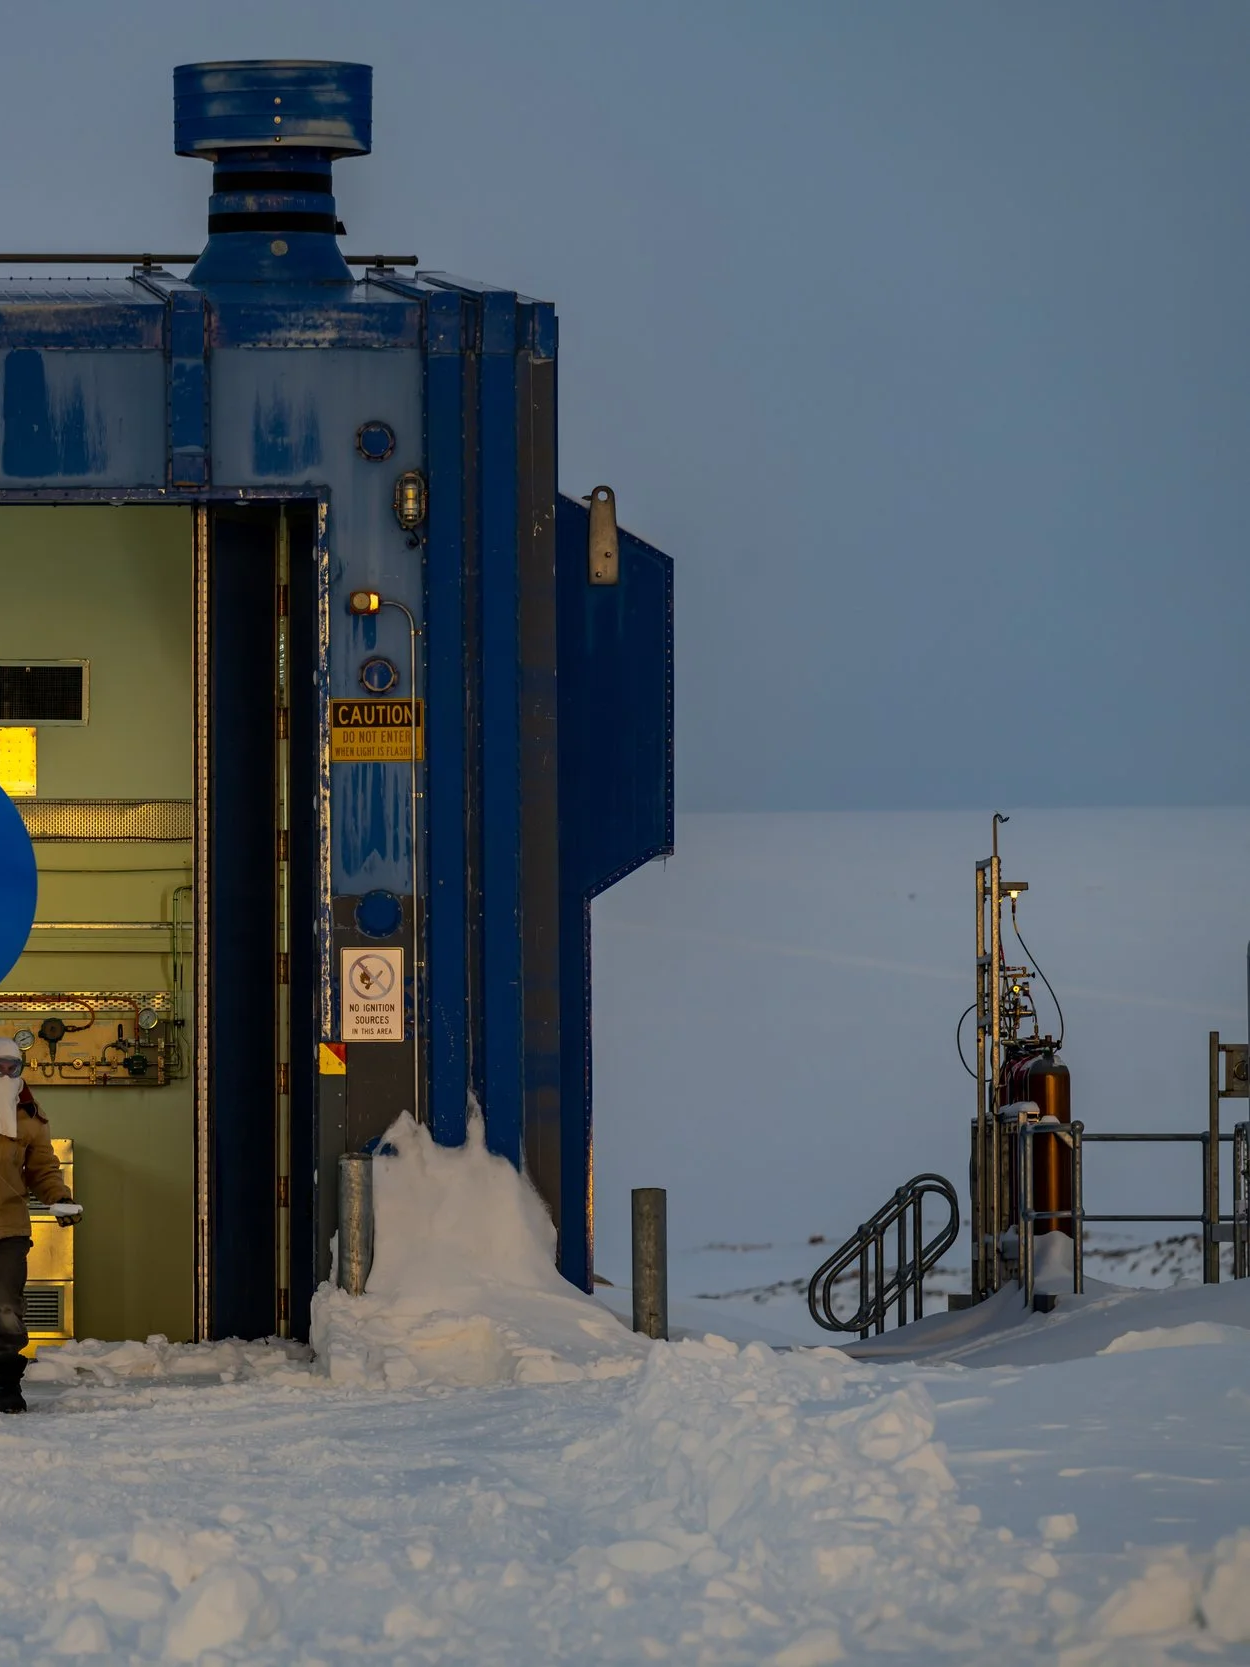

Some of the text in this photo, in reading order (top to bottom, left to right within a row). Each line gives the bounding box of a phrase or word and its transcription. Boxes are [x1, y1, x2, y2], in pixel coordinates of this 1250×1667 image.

[338, 705, 414, 725] CAUTION
[342, 730, 411, 743] DO NOT ENTER
[334, 746, 355, 757] WHEN
[356, 746, 376, 757] LIGHT
[377, 746, 385, 757] IS
[349, 1003, 395, 1012] NO IGNITION
[355, 1016, 390, 1025] SOURCES
